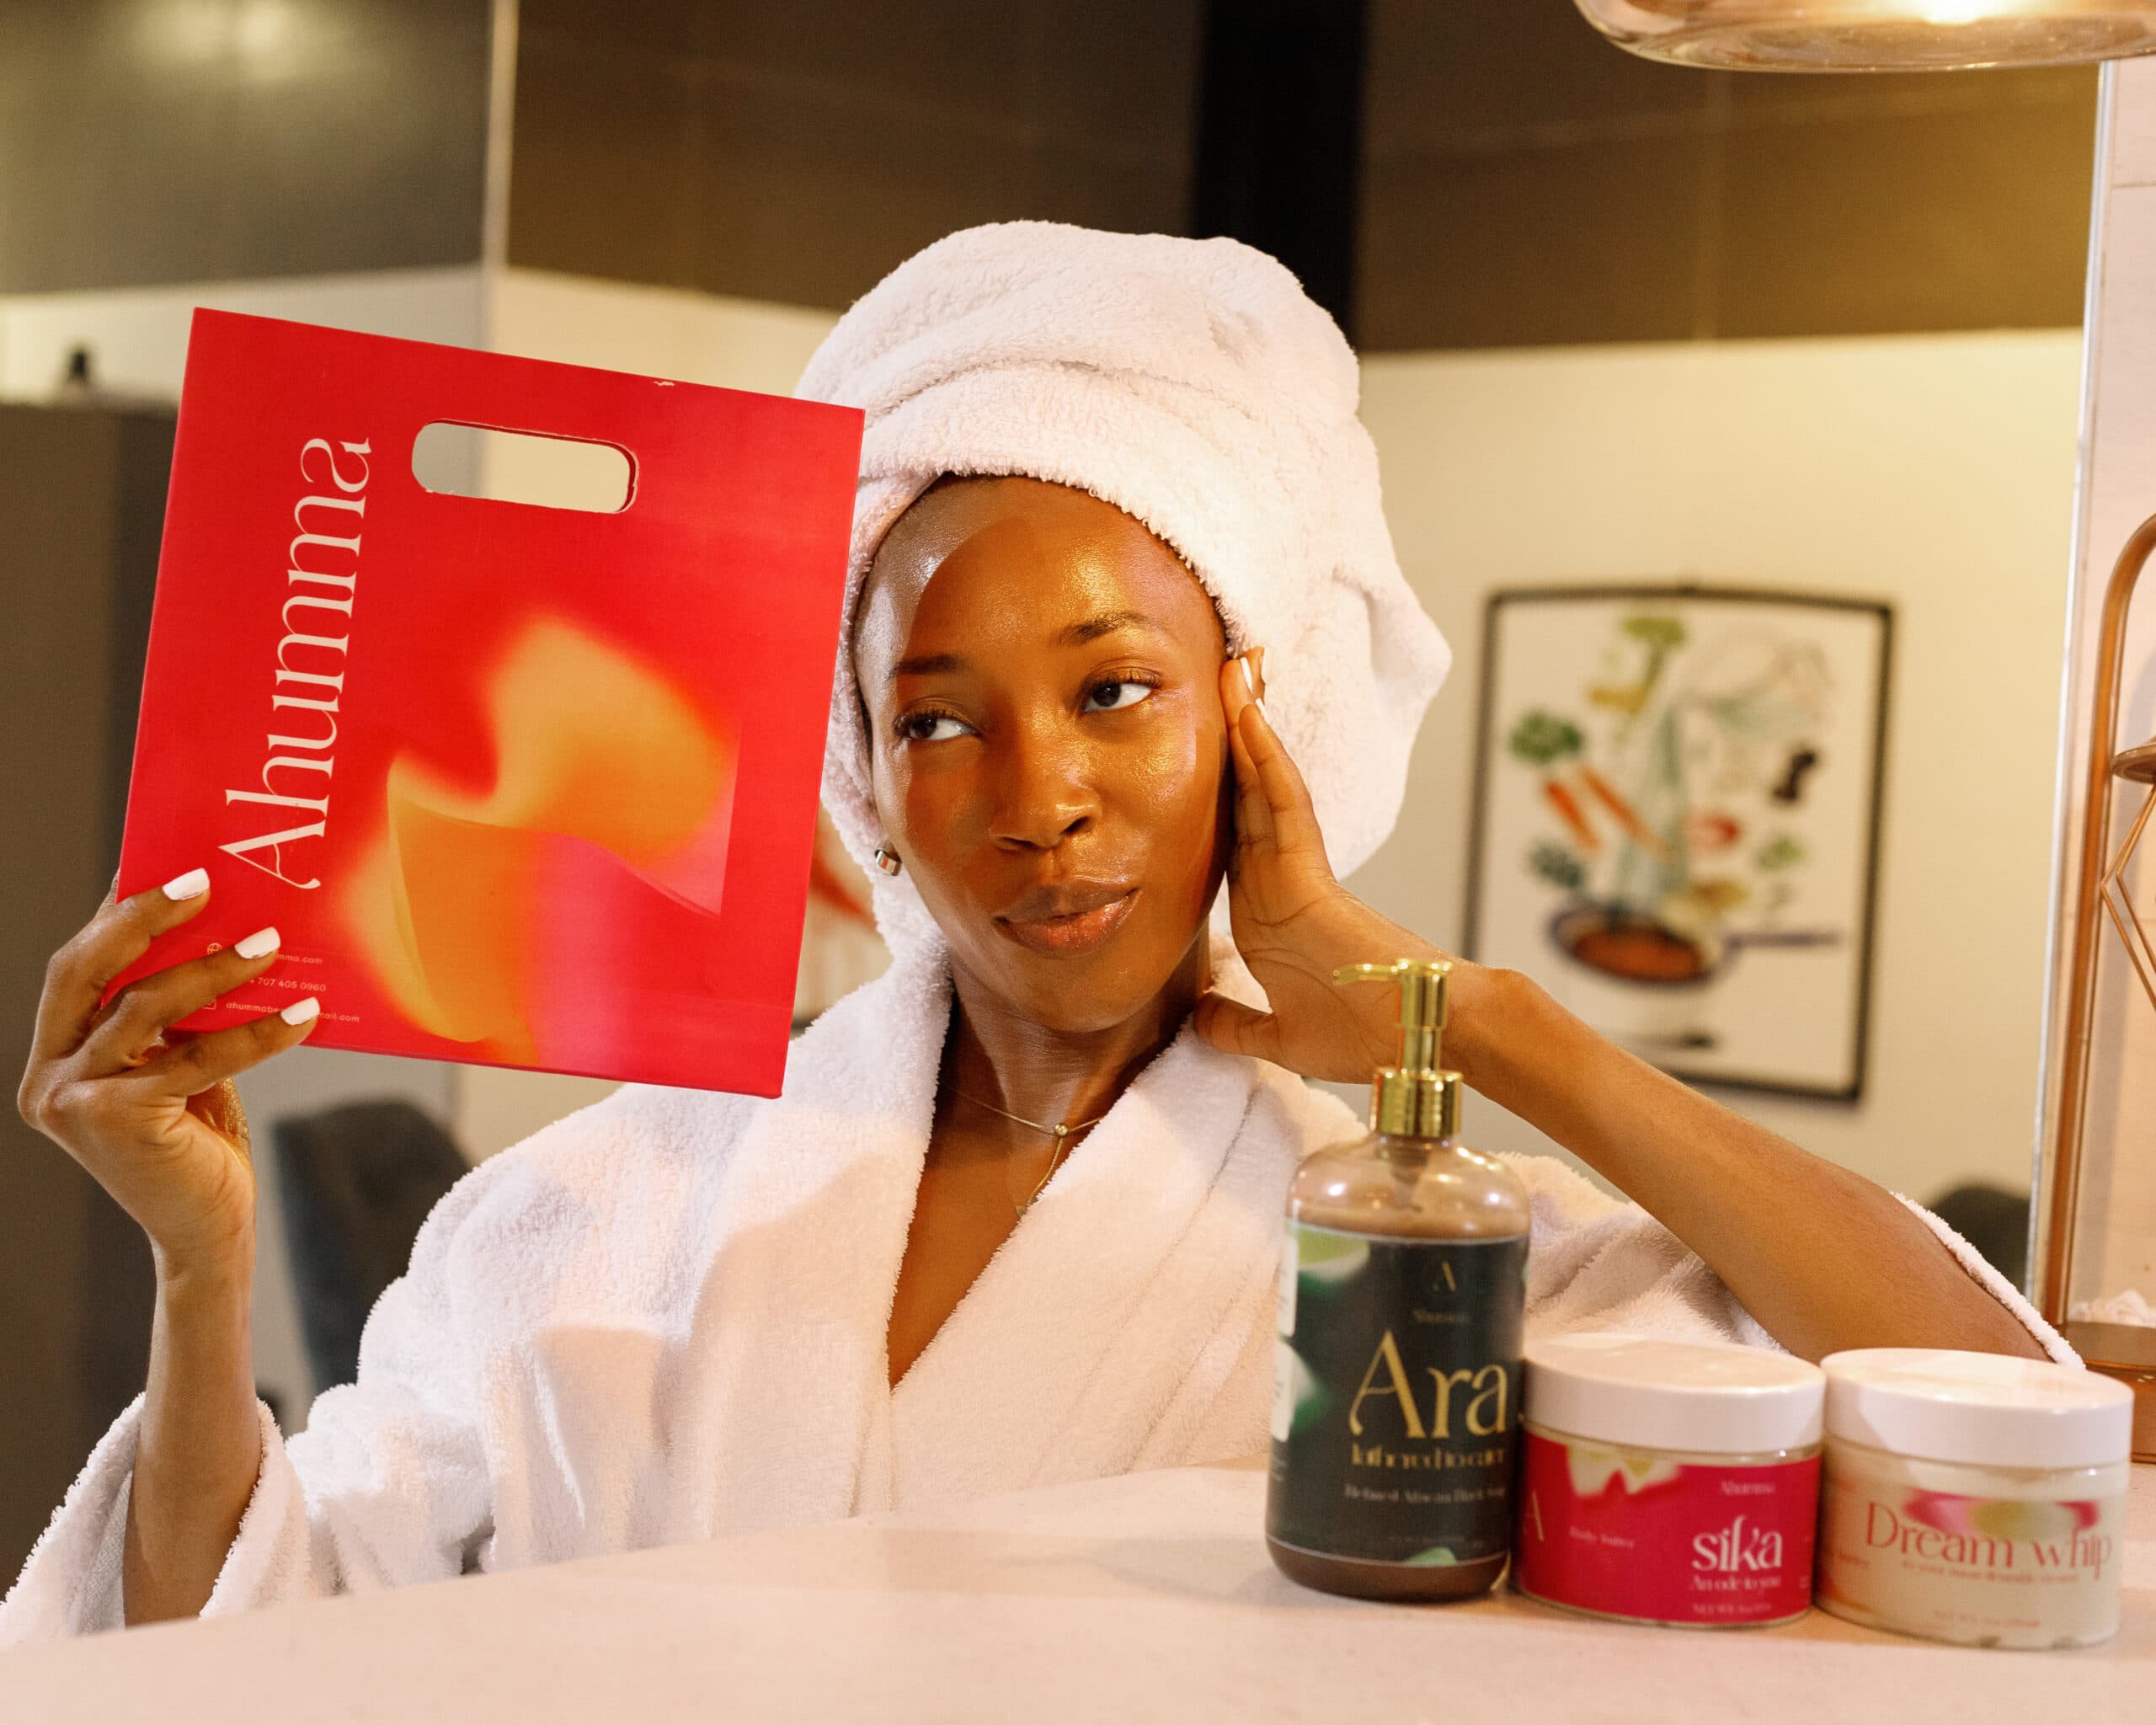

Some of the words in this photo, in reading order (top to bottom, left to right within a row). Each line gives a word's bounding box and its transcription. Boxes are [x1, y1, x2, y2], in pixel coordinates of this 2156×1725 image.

[217, 437, 372, 889] Ahumma
[258, 977, 275, 986] 707
[278, 980, 297, 989] 405
[1349, 1329, 1508, 1439] Ara
[1691, 1514, 1783, 1573] sika
[1865, 1501, 2014, 1568] Dream
[2028, 1521, 2114, 1581] whip
